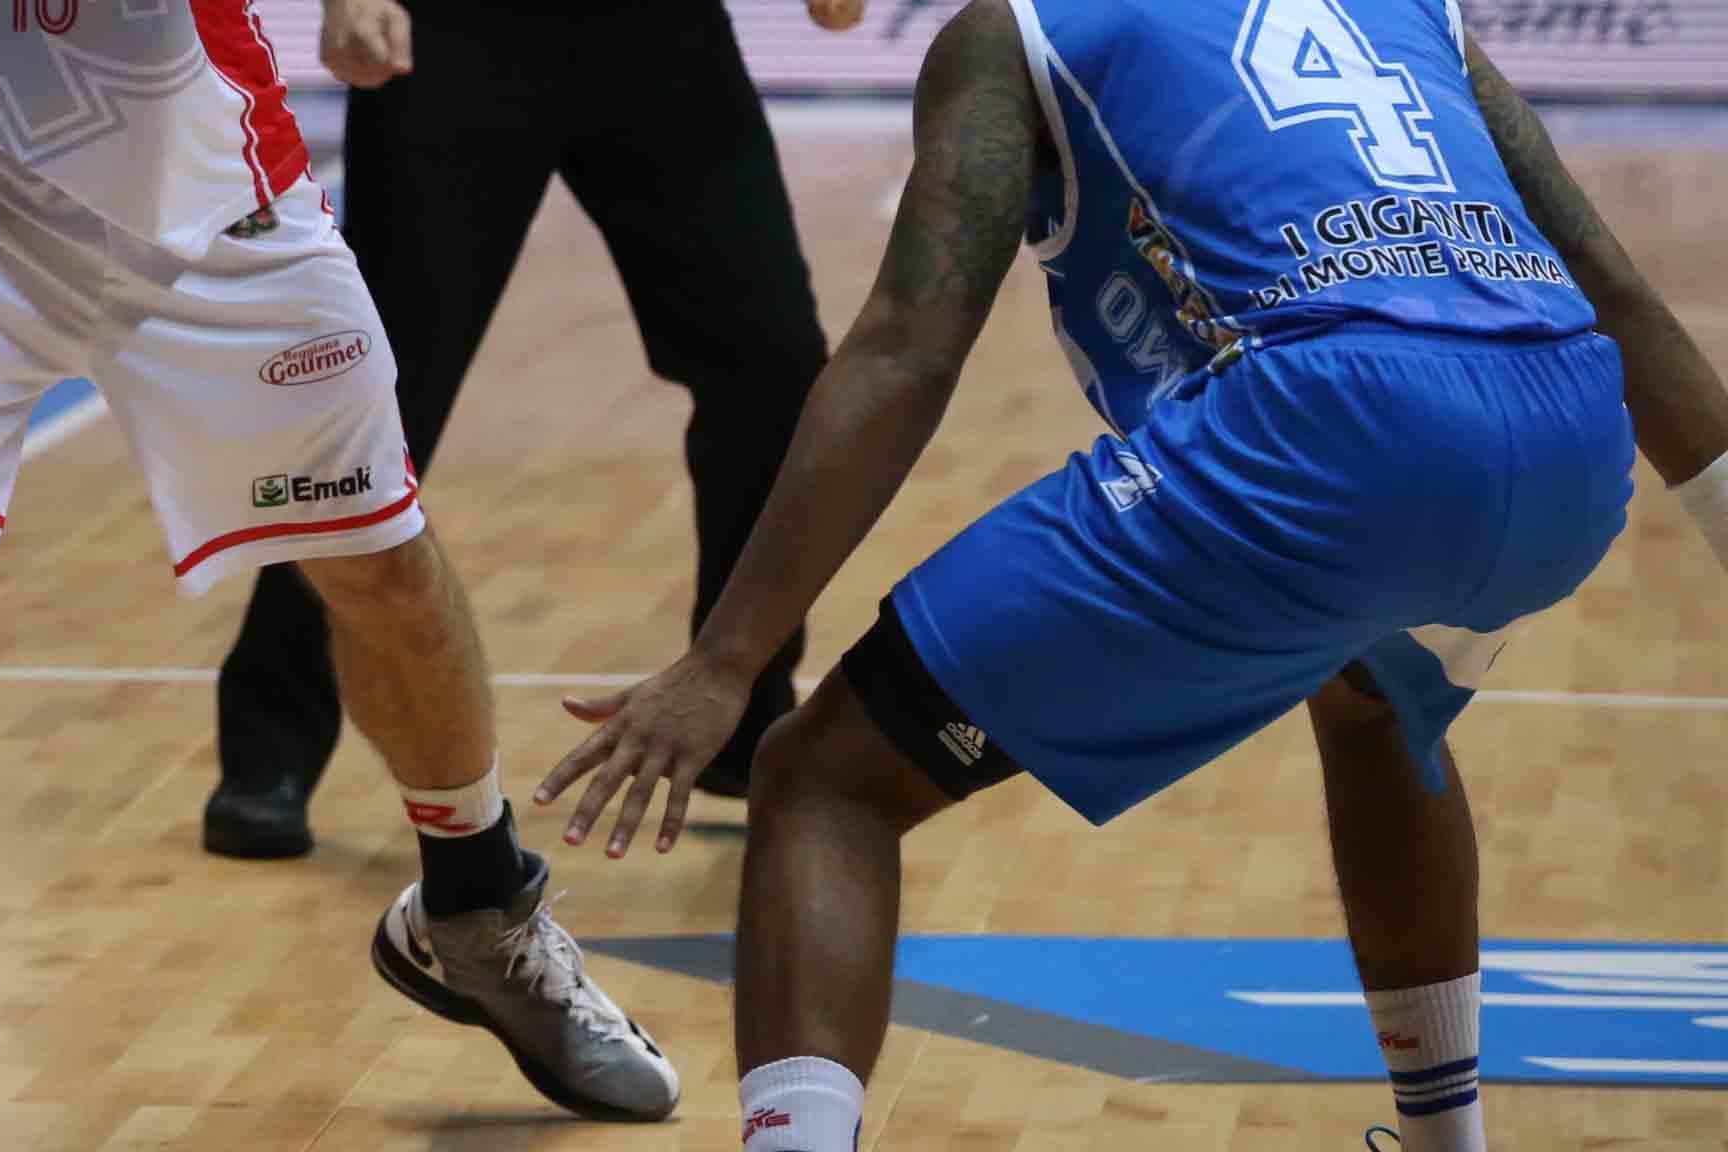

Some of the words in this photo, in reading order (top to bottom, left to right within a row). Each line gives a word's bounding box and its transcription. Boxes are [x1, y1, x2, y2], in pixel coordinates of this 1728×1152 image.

[1314, 195, 1517, 247] GIGANTI
[1300, 241, 1449, 292] MONTE
[268, 337, 364, 384] Gourmet
[291, 465, 372, 502] Emak
